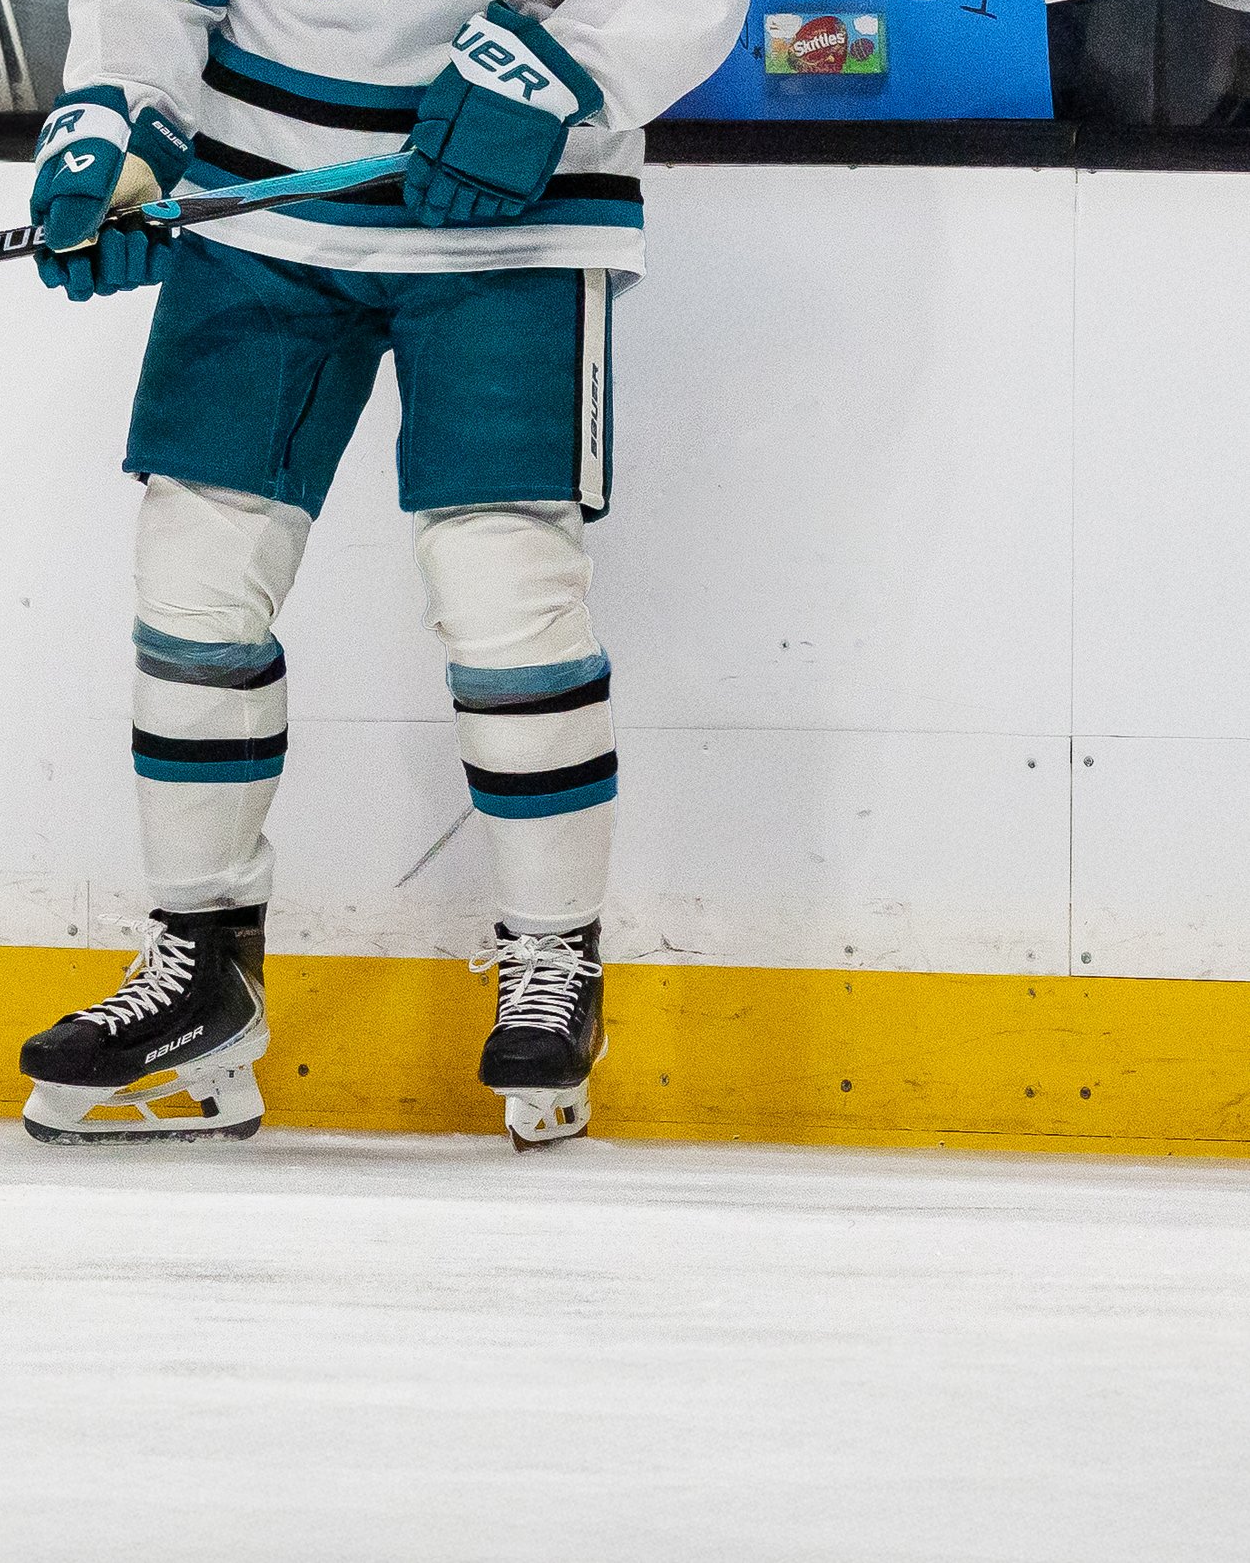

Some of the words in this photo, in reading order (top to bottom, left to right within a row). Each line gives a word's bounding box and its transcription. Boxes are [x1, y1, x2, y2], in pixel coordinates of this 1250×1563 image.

[793, 31, 846, 58] Skittles
[590, 362, 600, 460] BAUER
[145, 1025, 205, 1065] BAUER
